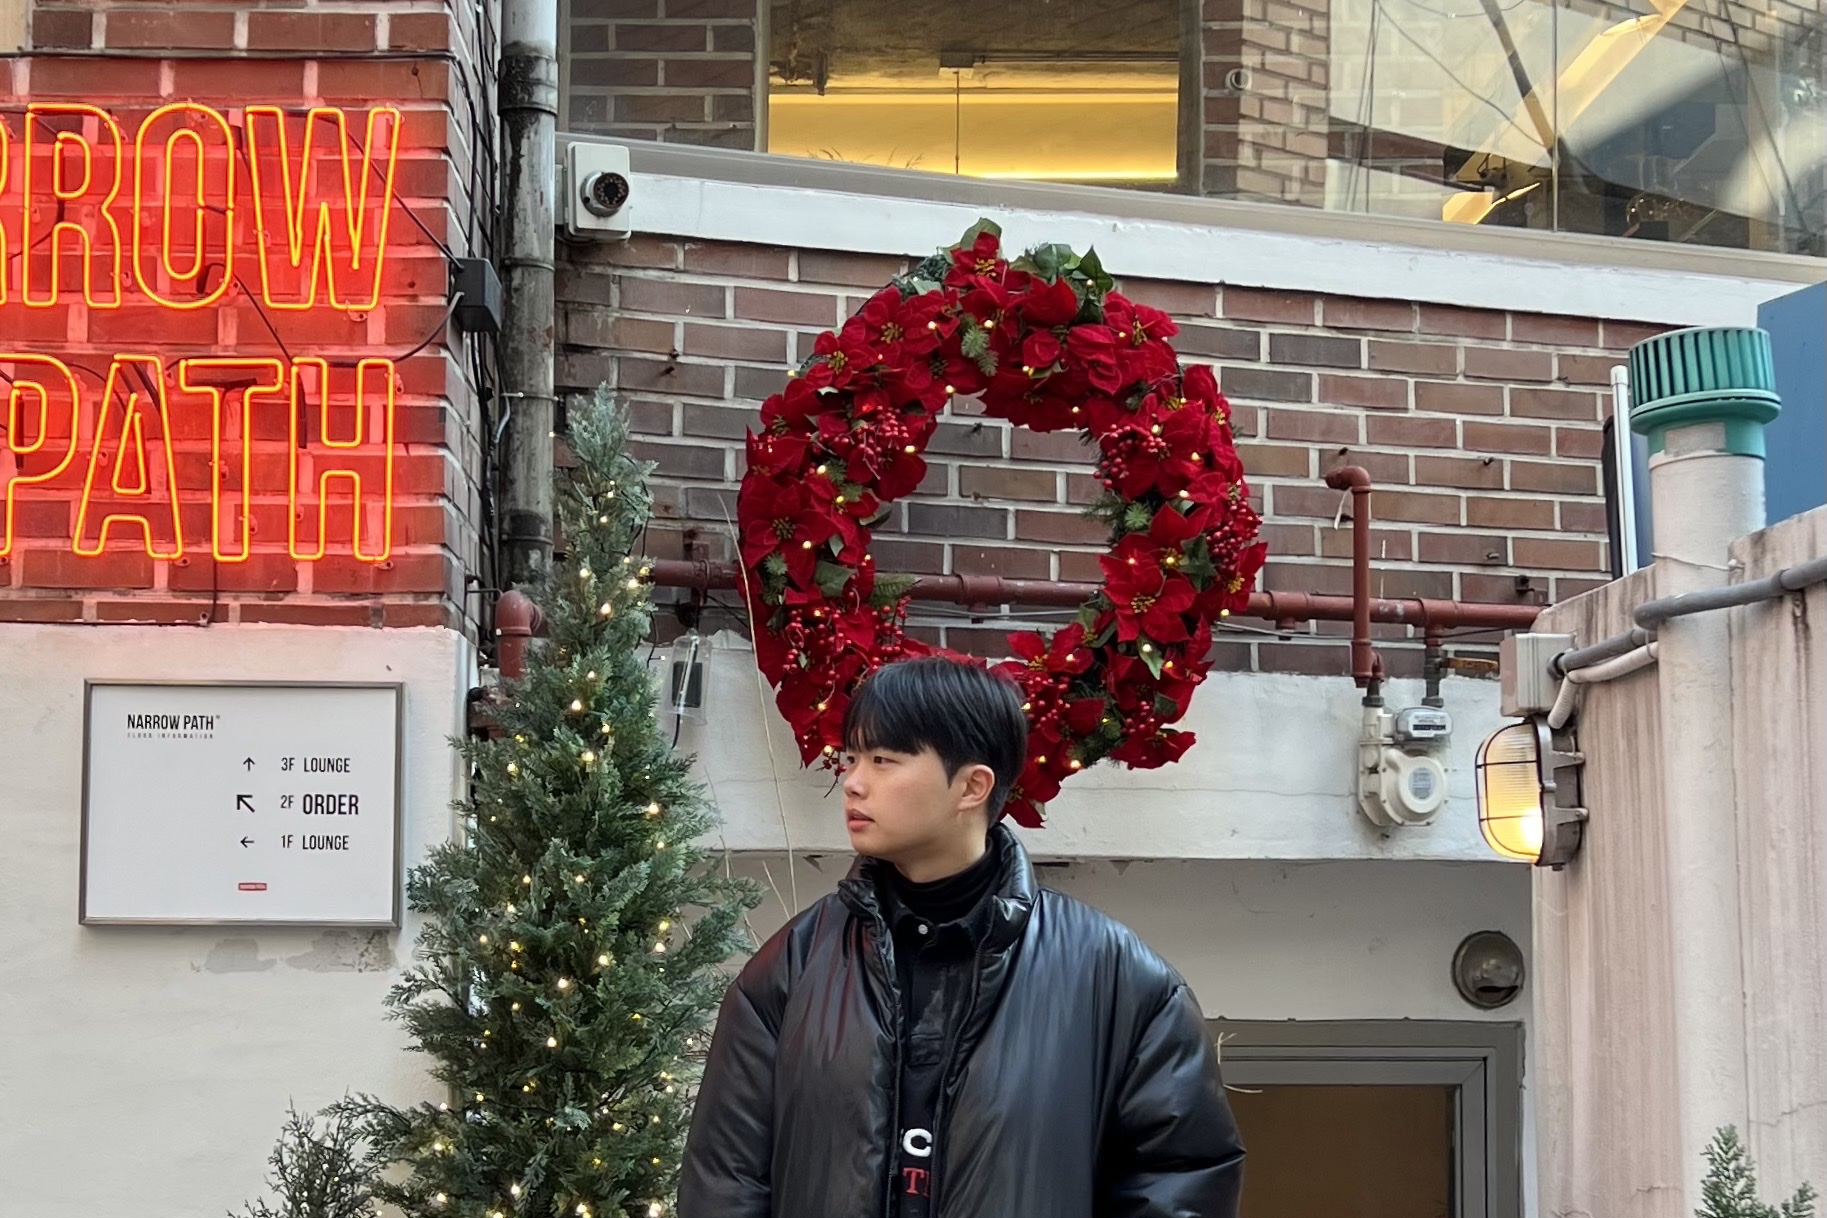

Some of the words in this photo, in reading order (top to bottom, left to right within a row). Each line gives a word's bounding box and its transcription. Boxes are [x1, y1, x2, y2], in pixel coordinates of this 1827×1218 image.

[0, 353, 395, 563] PATH
[127, 714, 180, 730] NARROW
[183, 715, 214, 730] PATH
[281, 757, 295, 771] 3F
[303, 757, 351, 773] LOUNGE
[280, 794, 295, 809] 2F
[302, 793, 359, 815] ORDER
[281, 834, 293, 849] 1F
[302, 834, 350, 850] LOUNGE
